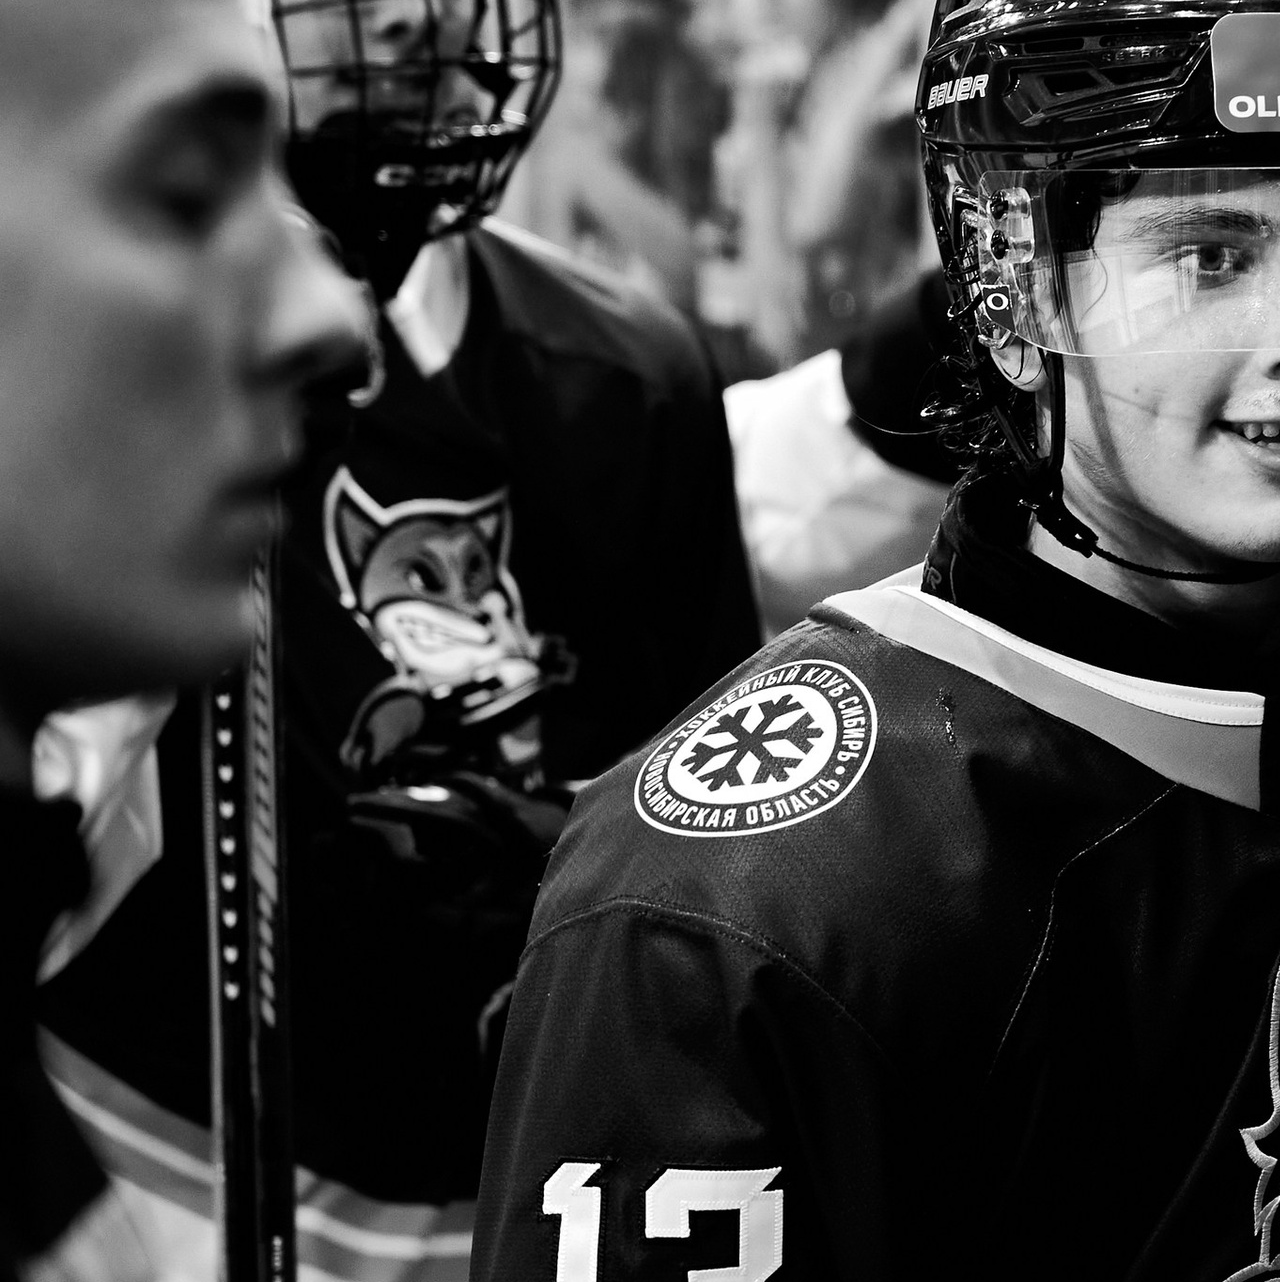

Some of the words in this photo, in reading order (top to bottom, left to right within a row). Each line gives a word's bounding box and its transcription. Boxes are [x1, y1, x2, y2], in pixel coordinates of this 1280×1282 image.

[675, 665, 803, 741] ХОККЕЙНЫЙ
[800, 666, 850, 699] КЛУБ
[837, 696, 867, 763] СИБИРЬ
[643, 751, 738, 828] НОВОСИБИРСКАЯ
[746, 777, 841, 826] ОБЛАСТЬ
